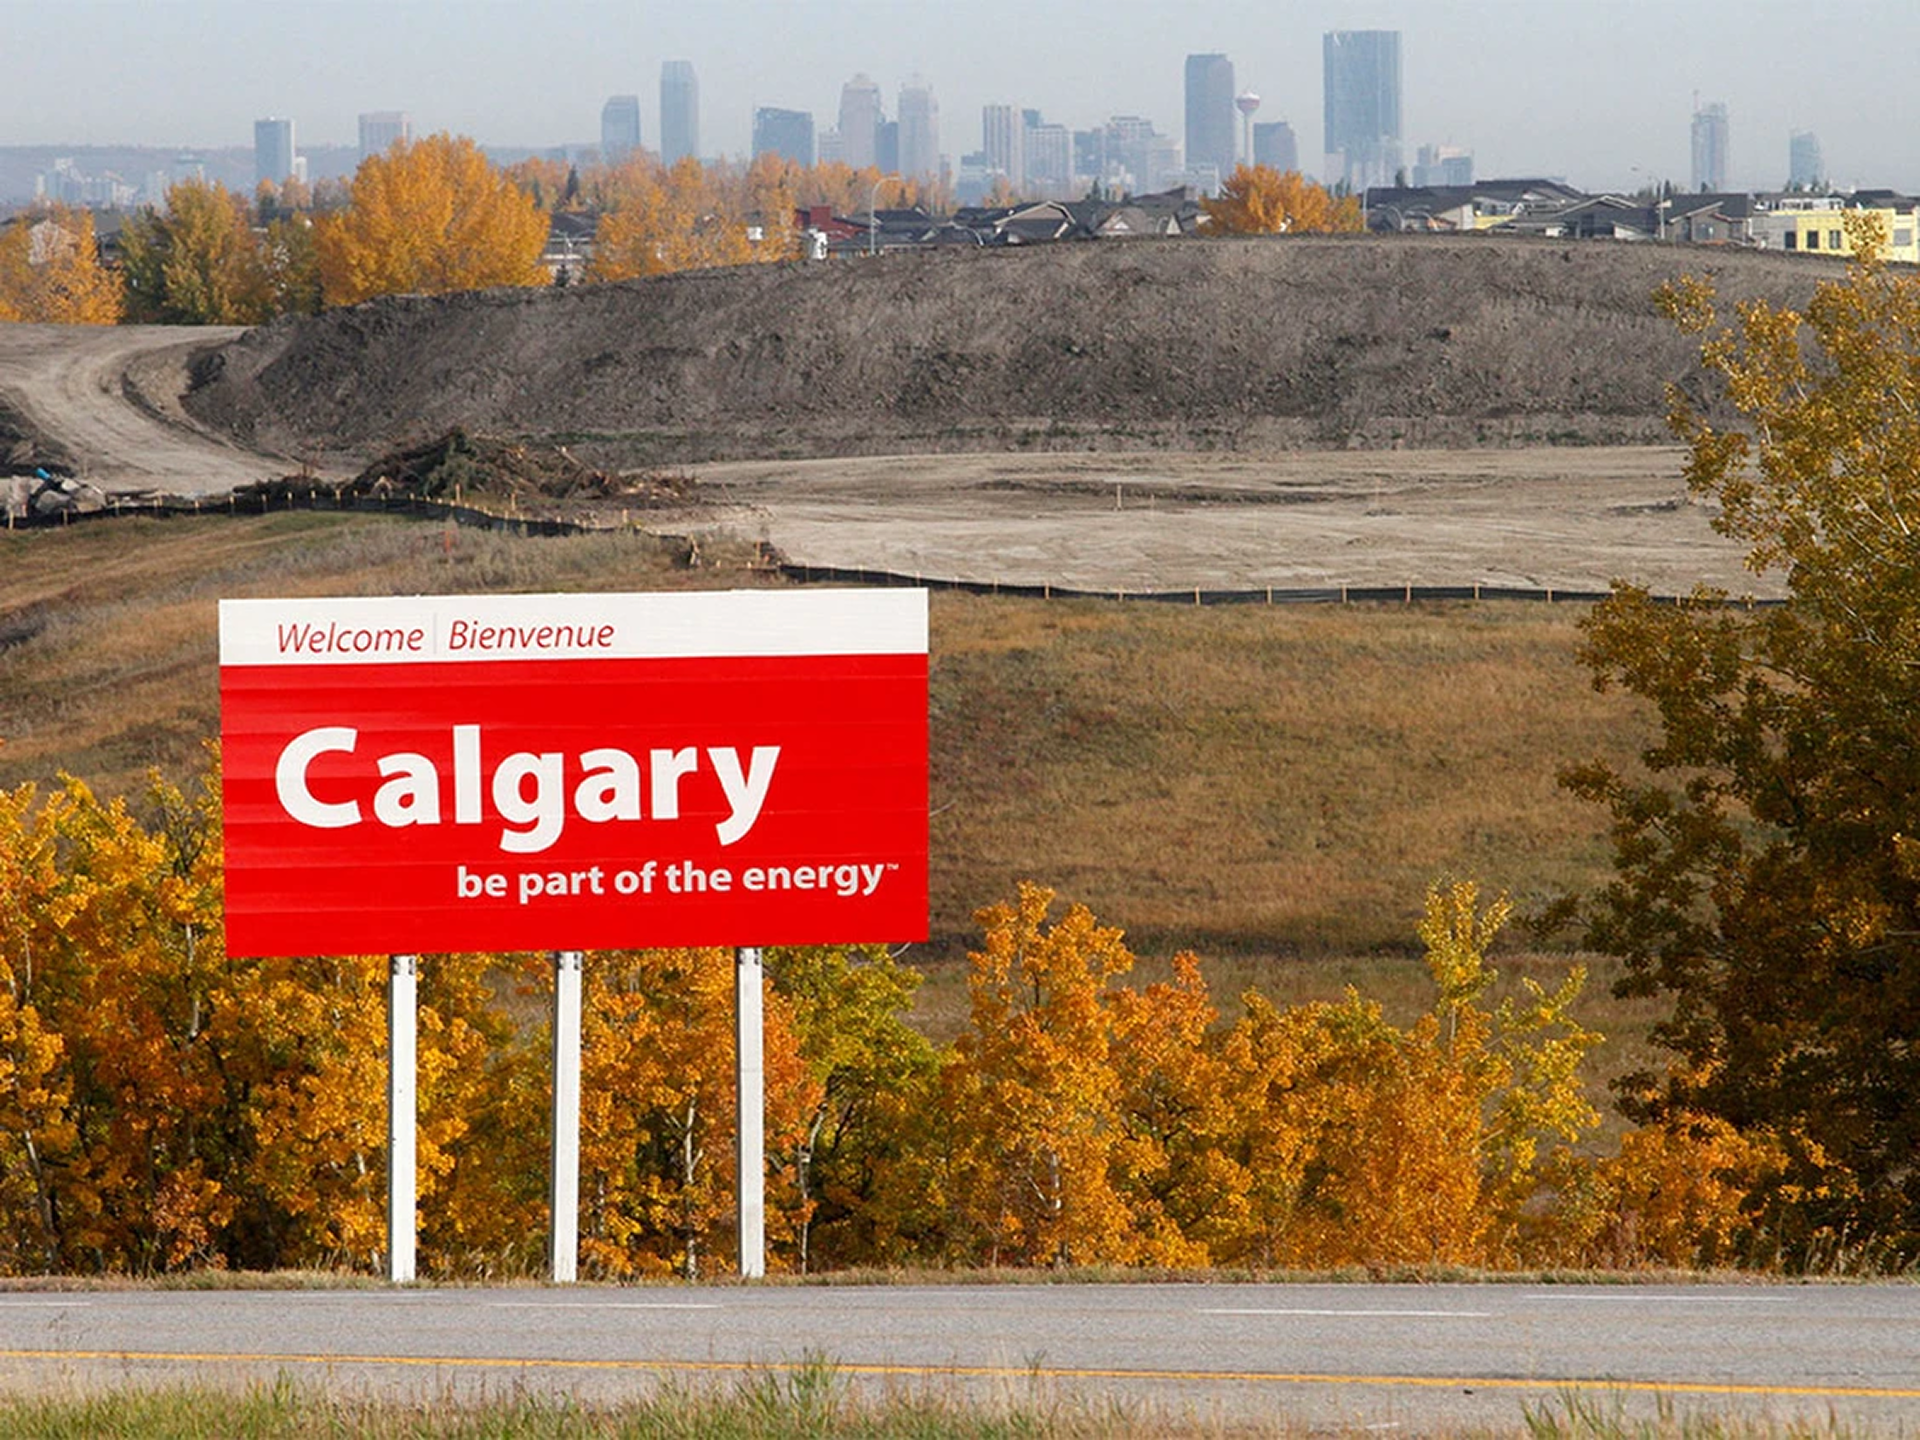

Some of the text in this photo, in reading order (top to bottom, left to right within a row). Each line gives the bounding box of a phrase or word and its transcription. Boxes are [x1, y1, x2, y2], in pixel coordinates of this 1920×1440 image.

[277, 620, 614, 653] Welcome Bienvenue
[275, 724, 780, 853] Calgary
[458, 866, 507, 897] be
[519, 867, 604, 904] part
[615, 861, 657, 893] of
[665, 861, 732, 892] the
